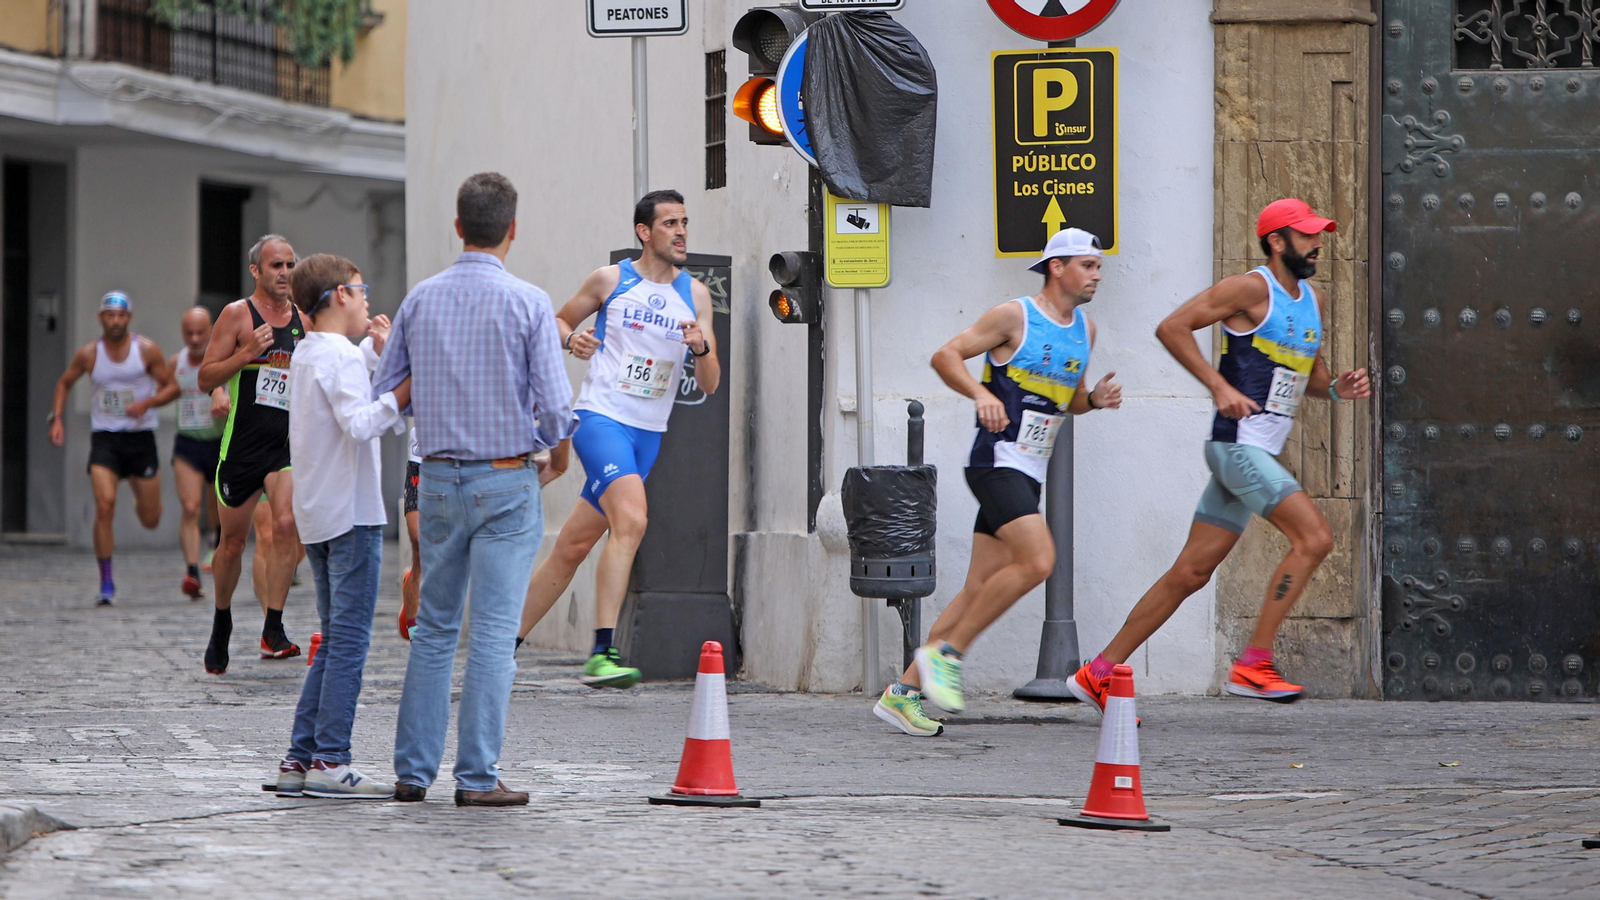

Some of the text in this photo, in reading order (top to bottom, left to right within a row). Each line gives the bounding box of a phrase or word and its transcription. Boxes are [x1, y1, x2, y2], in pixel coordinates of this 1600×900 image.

[607, 7, 669, 21] PEATONES
[1033, 68, 1079, 137] P
[1012, 150, 1097, 173] PÚBLICO
[1014, 178, 1095, 196] Los Cisnes
[626, 363, 651, 381] 156
[261, 378, 286, 394] 279
[1024, 424, 1048, 442] 785
